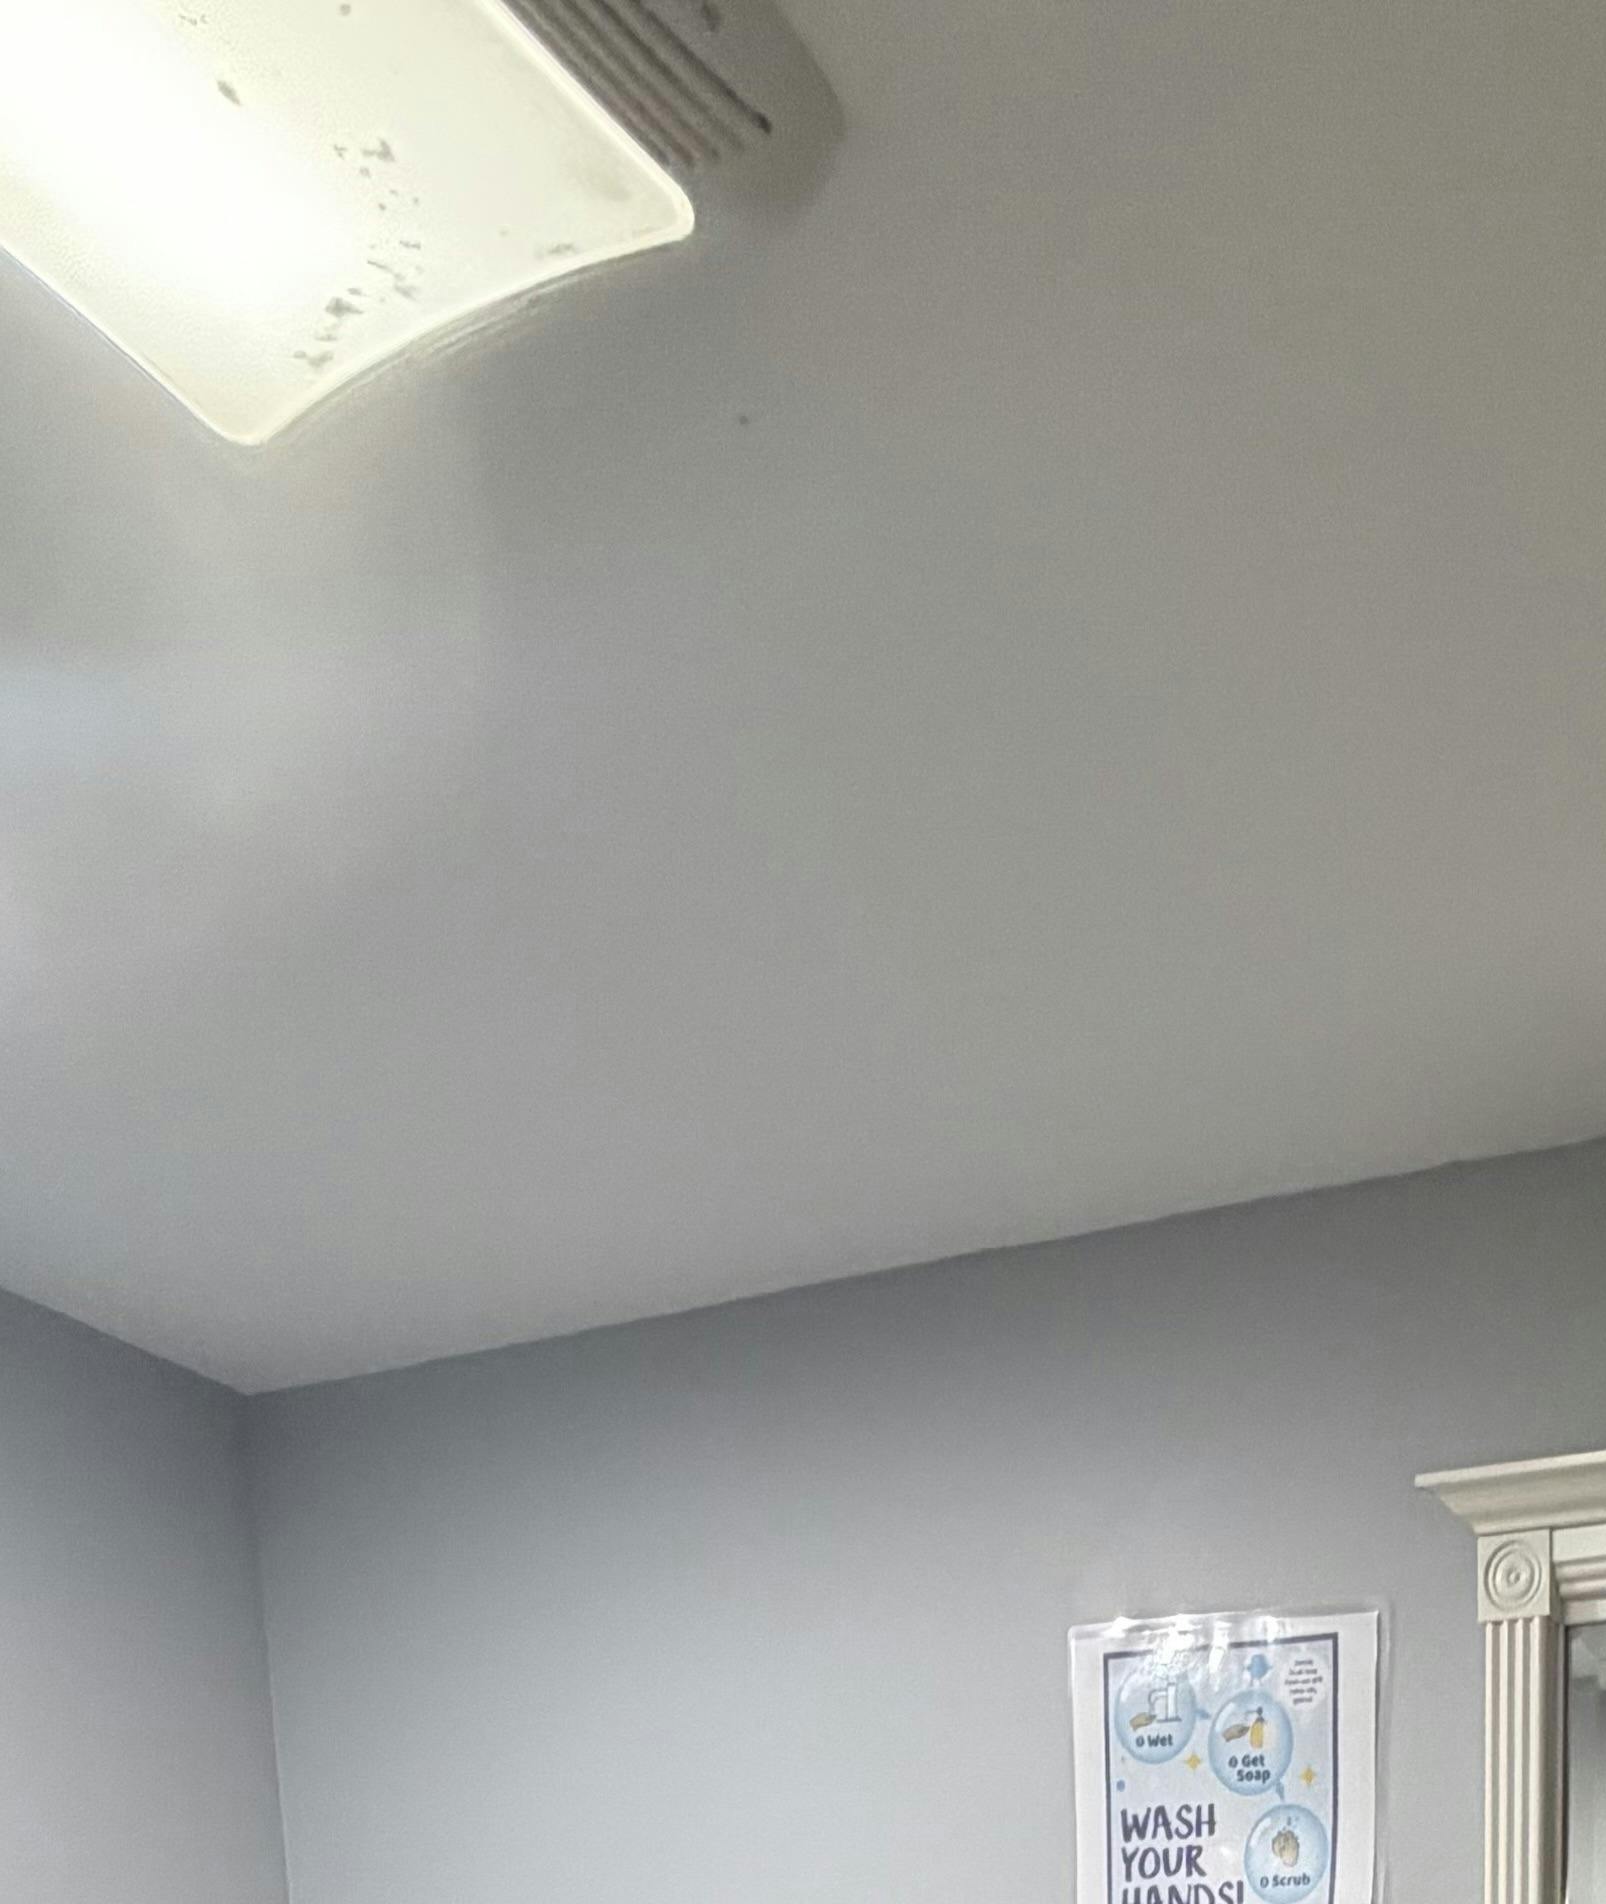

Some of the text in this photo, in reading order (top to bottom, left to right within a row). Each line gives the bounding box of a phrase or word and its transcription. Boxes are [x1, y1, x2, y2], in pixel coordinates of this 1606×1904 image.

[1148, 1734, 1174, 1747] Wet
[1241, 1754, 1266, 1768] Get
[1236, 1769, 1271, 1784] Soap
[1119, 1804, 1217, 1842] WASH
[1120, 1845, 1207, 1882] YOUR
[1272, 1873, 1311, 1888] Scrub
